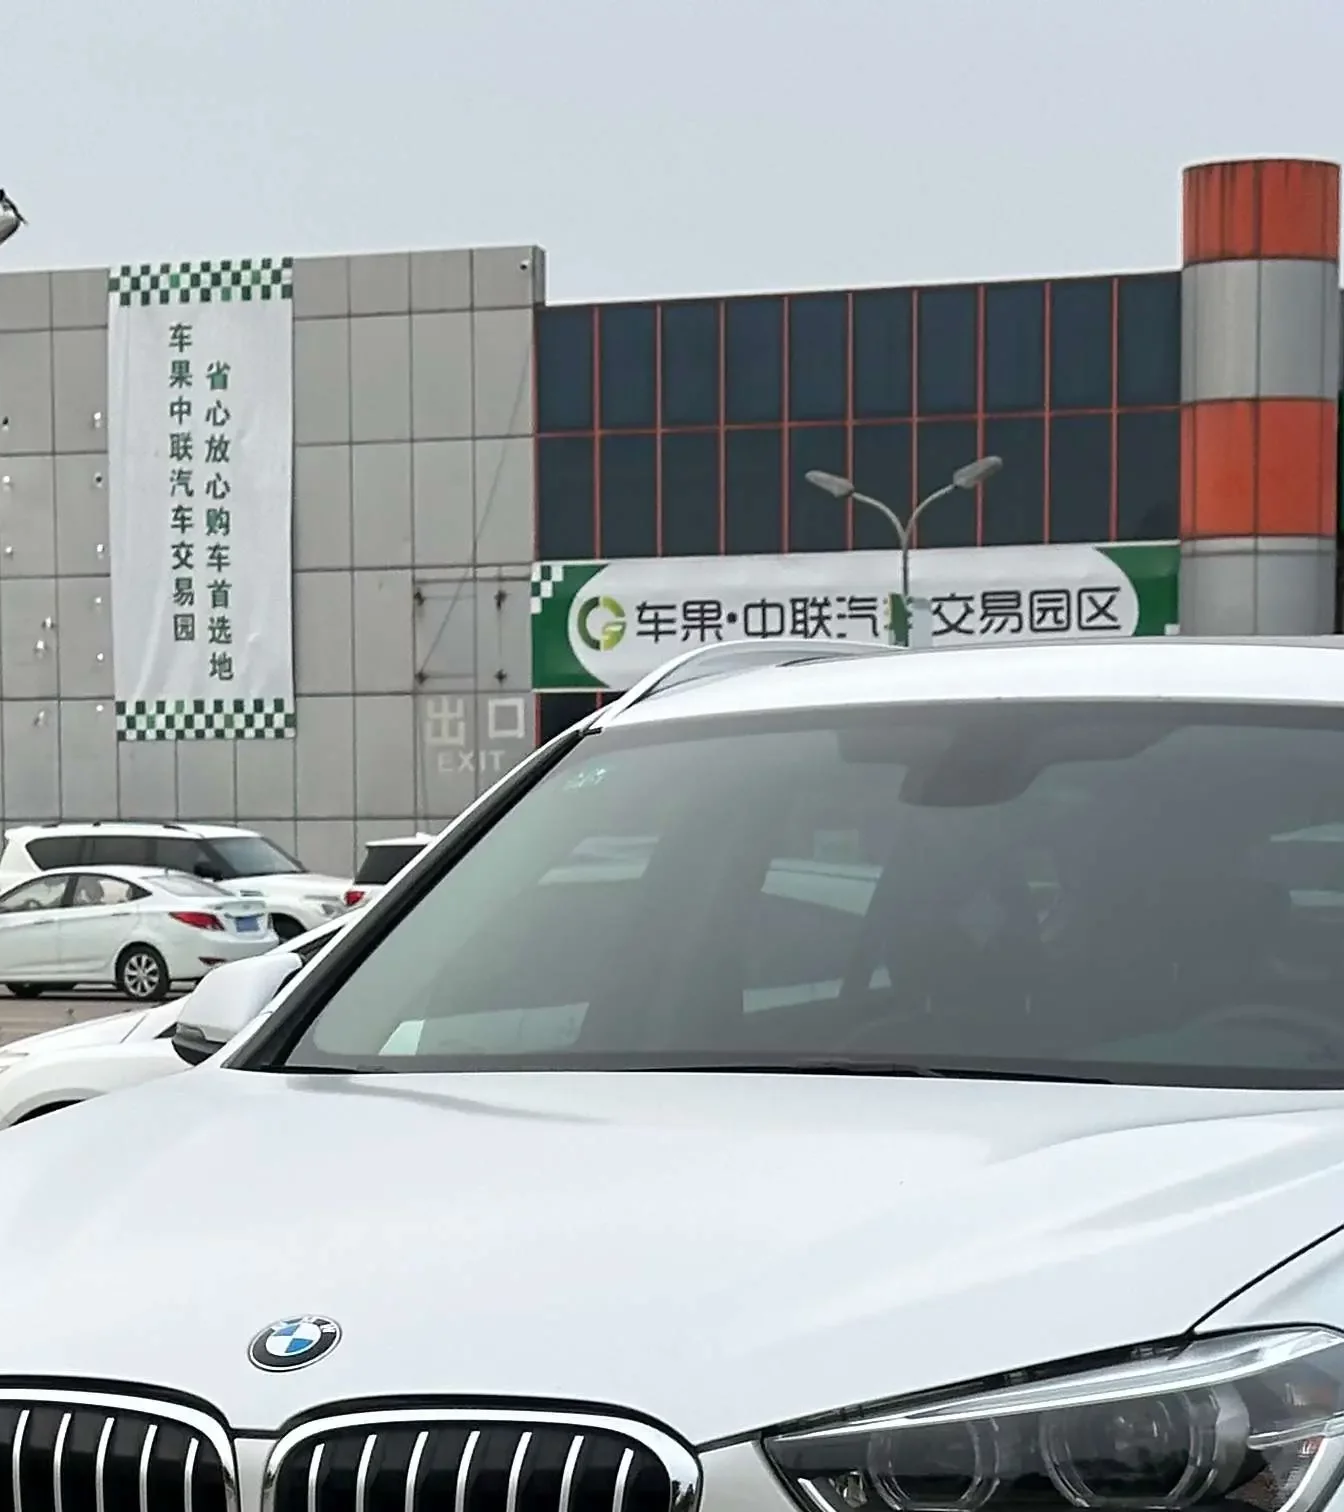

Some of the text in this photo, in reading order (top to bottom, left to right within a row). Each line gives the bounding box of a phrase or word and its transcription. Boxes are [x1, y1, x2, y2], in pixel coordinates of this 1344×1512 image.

[169, 323, 195, 642] 车果中联汽车交易园
[205, 360, 234, 681] 省心放心购车首选地
[636, 587, 1122, 643] 车果·中联汽交易园区
[426, 696, 525, 746] 出口
[437, 750, 506, 772] EXIT
